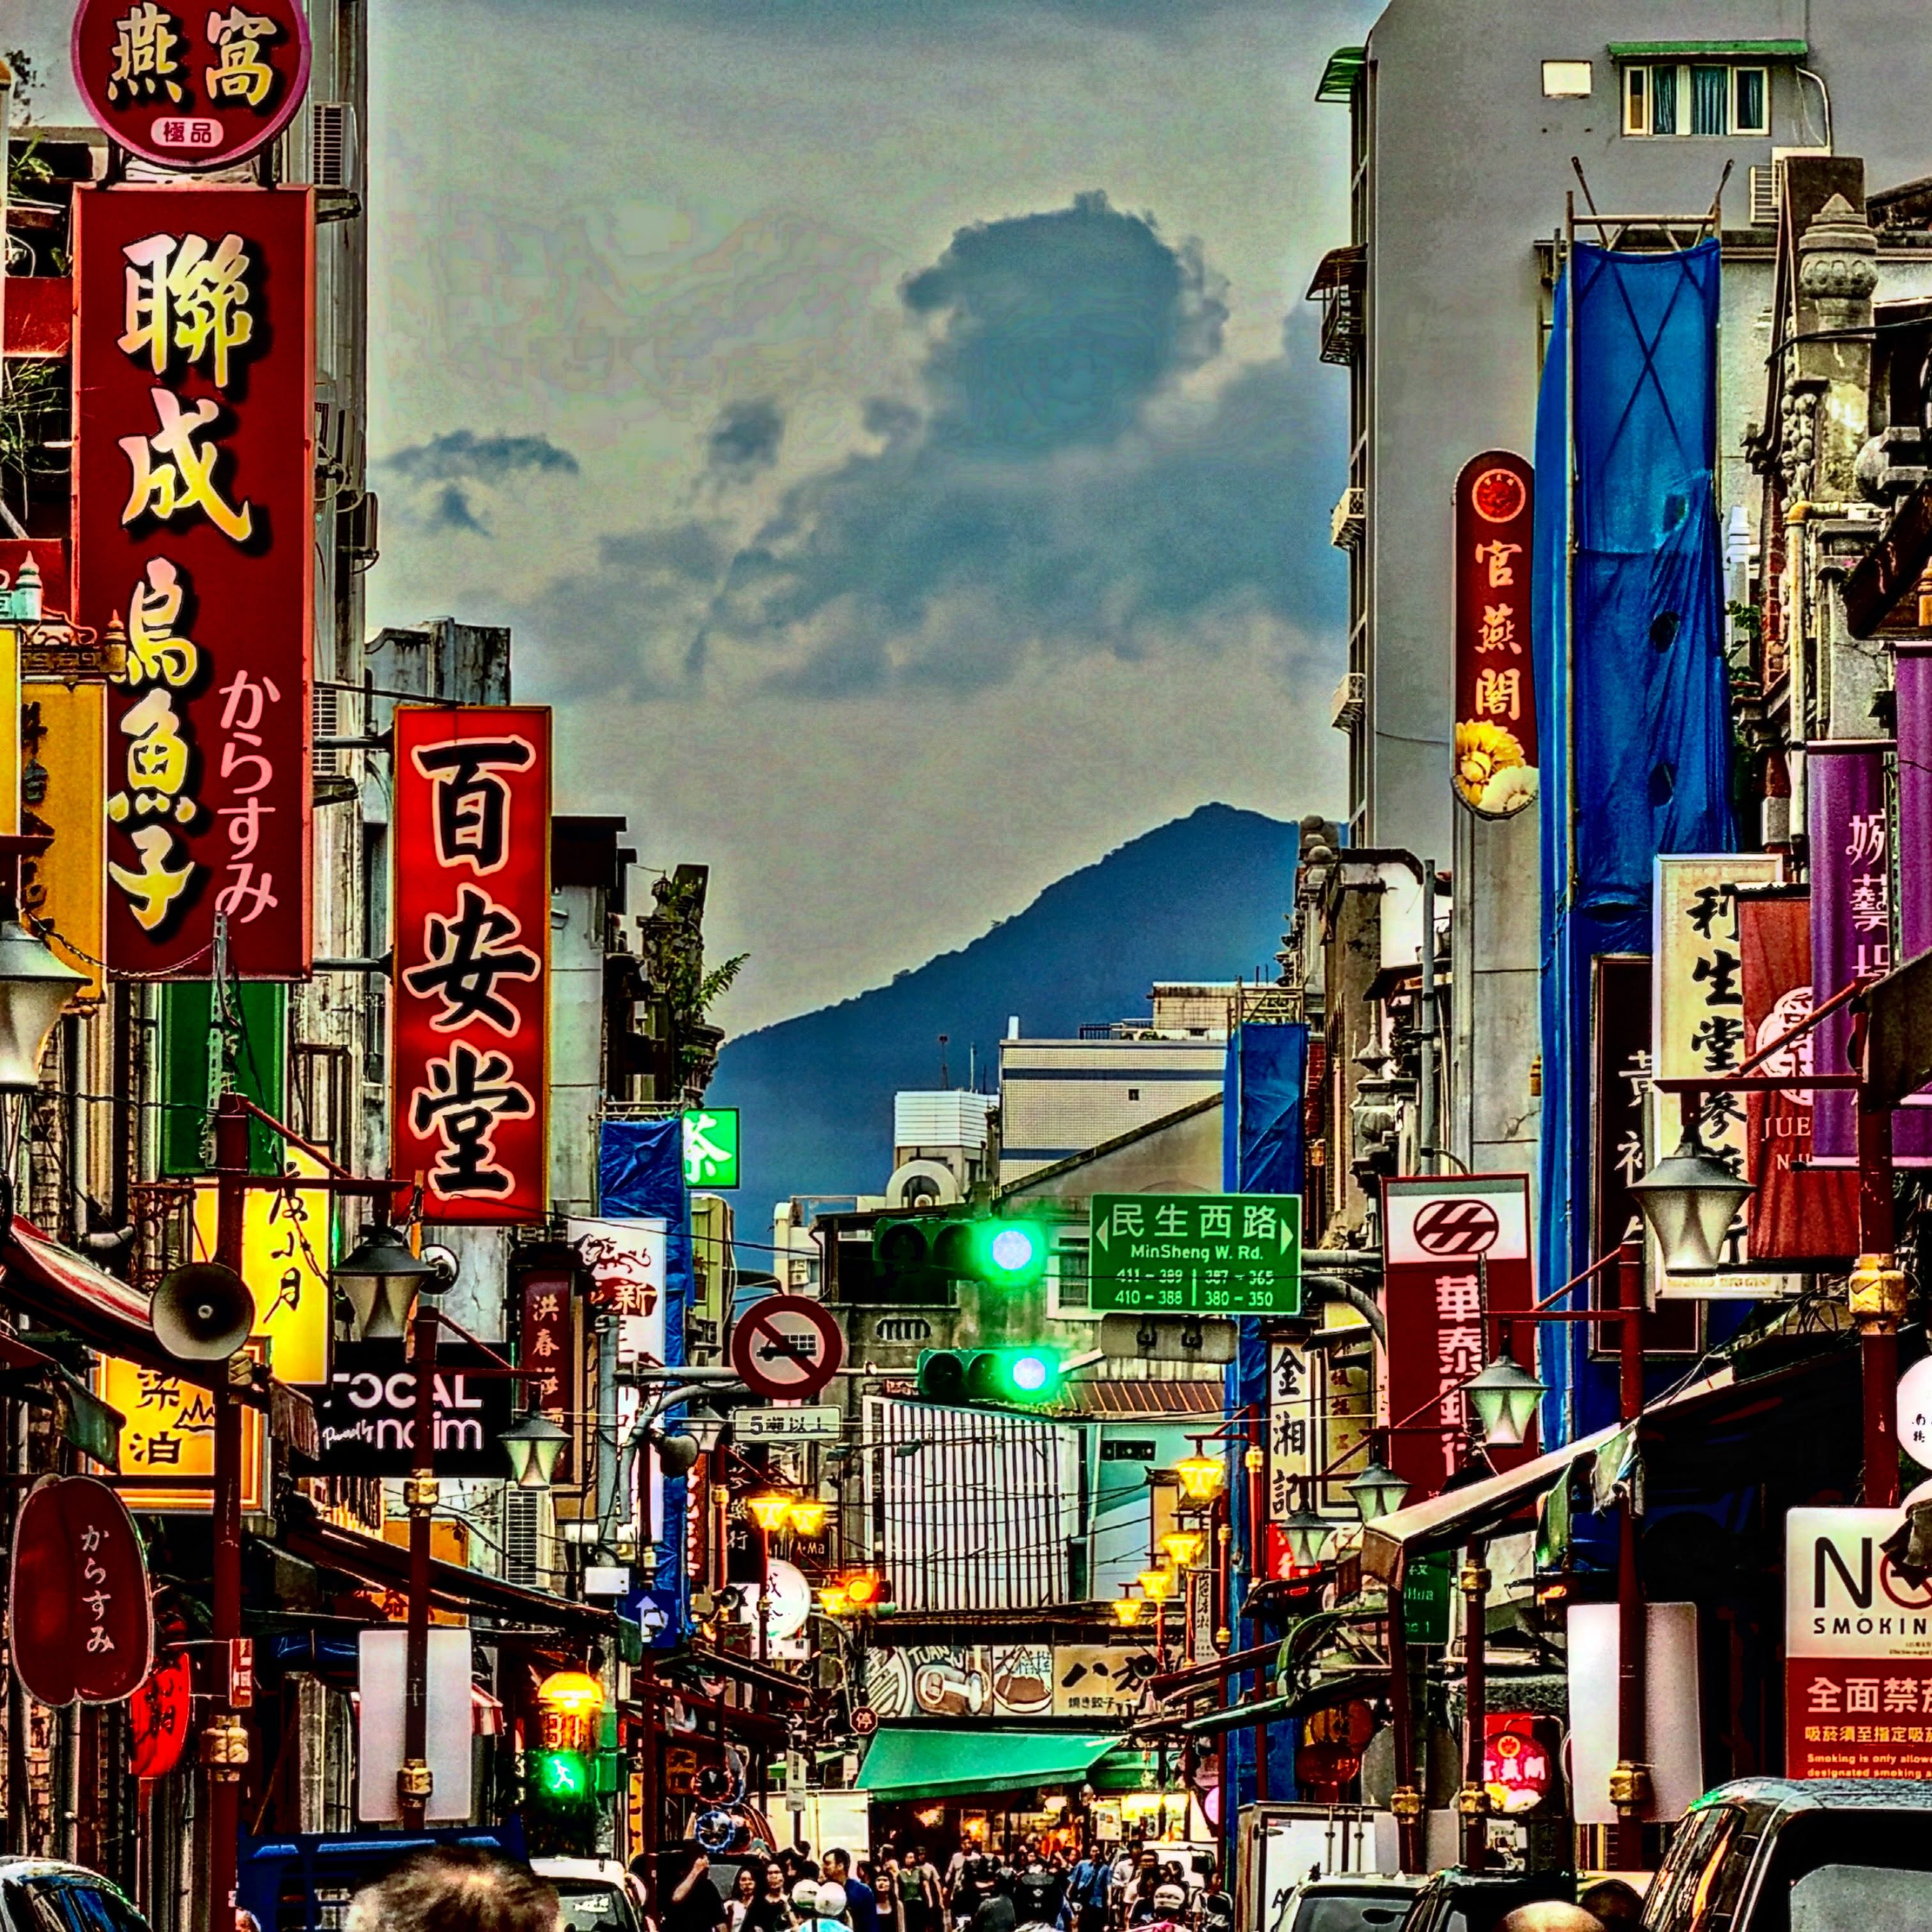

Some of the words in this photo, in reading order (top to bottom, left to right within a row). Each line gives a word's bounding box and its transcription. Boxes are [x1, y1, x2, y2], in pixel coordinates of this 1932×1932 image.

[108, 2, 277, 105] 燕窩
[164, 121, 211, 142] 極品
[1475, 540, 1522, 719] 官燕閣
[218, 670, 280, 923] からすみ
[404, 736, 540, 1200] 百安堂
[684, 1114, 733, 1183] 茶
[1113, 1204, 1276, 1239] 民生西路
[1131, 1245, 1209, 1263] MinSheng
[1215, 1246, 1232, 1259] W.
[1238, 1246, 1263, 1260] Rd.
[1115, 1290, 1140, 1305] 410
[1158, 1291, 1182, 1305] 388
[1205, 1291, 1229, 1306] 380
[1248, 1291, 1273, 1307] 350
[81, 1525, 114, 1653] からすみ
[1813, 1618, 1927, 1635] SMOKIN
[1807, 1754, 1856, 1765] Smoking
[1873, 1755, 1896, 1765] only
[1807, 1769, 1869, 1779] designated
[1874, 1769, 1921, 1779] smoking
